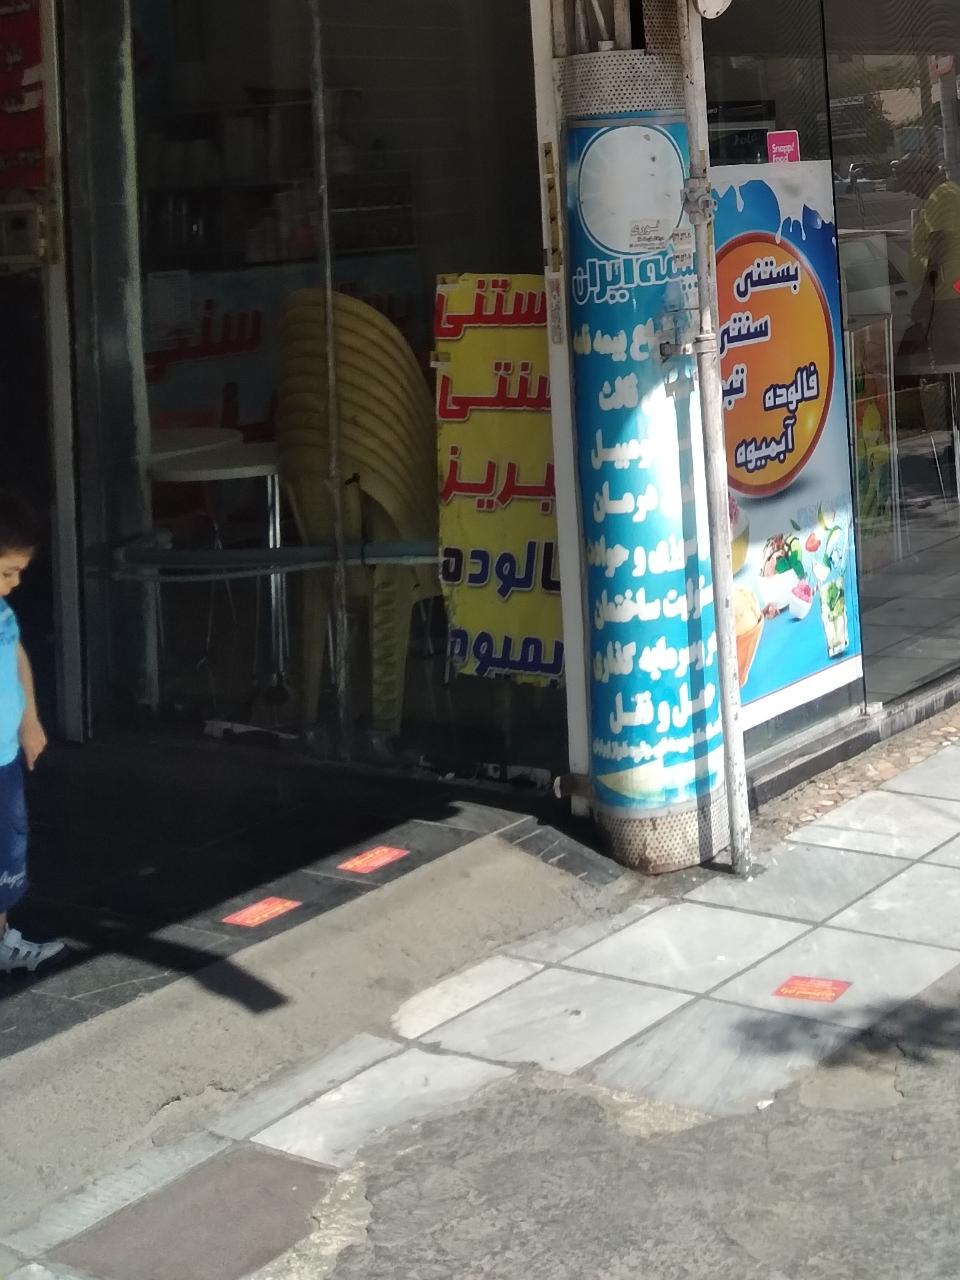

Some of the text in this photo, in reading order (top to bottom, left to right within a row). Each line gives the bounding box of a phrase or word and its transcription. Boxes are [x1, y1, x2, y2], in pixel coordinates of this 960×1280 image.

[771, 143, 794, 154] Snapp!
[772, 155, 788, 163] Food
[572, 258, 636, 305] ایران
[736, 259, 800, 300] بستنی
[434, 279, 547, 338] ستنی
[764, 363, 819, 410] فالوده
[735, 415, 796, 469] آبمیوه
[440, 445, 556, 513] بریز
[441, 541, 561, 598] الوده
[449, 628, 565, 688] بمیوه
